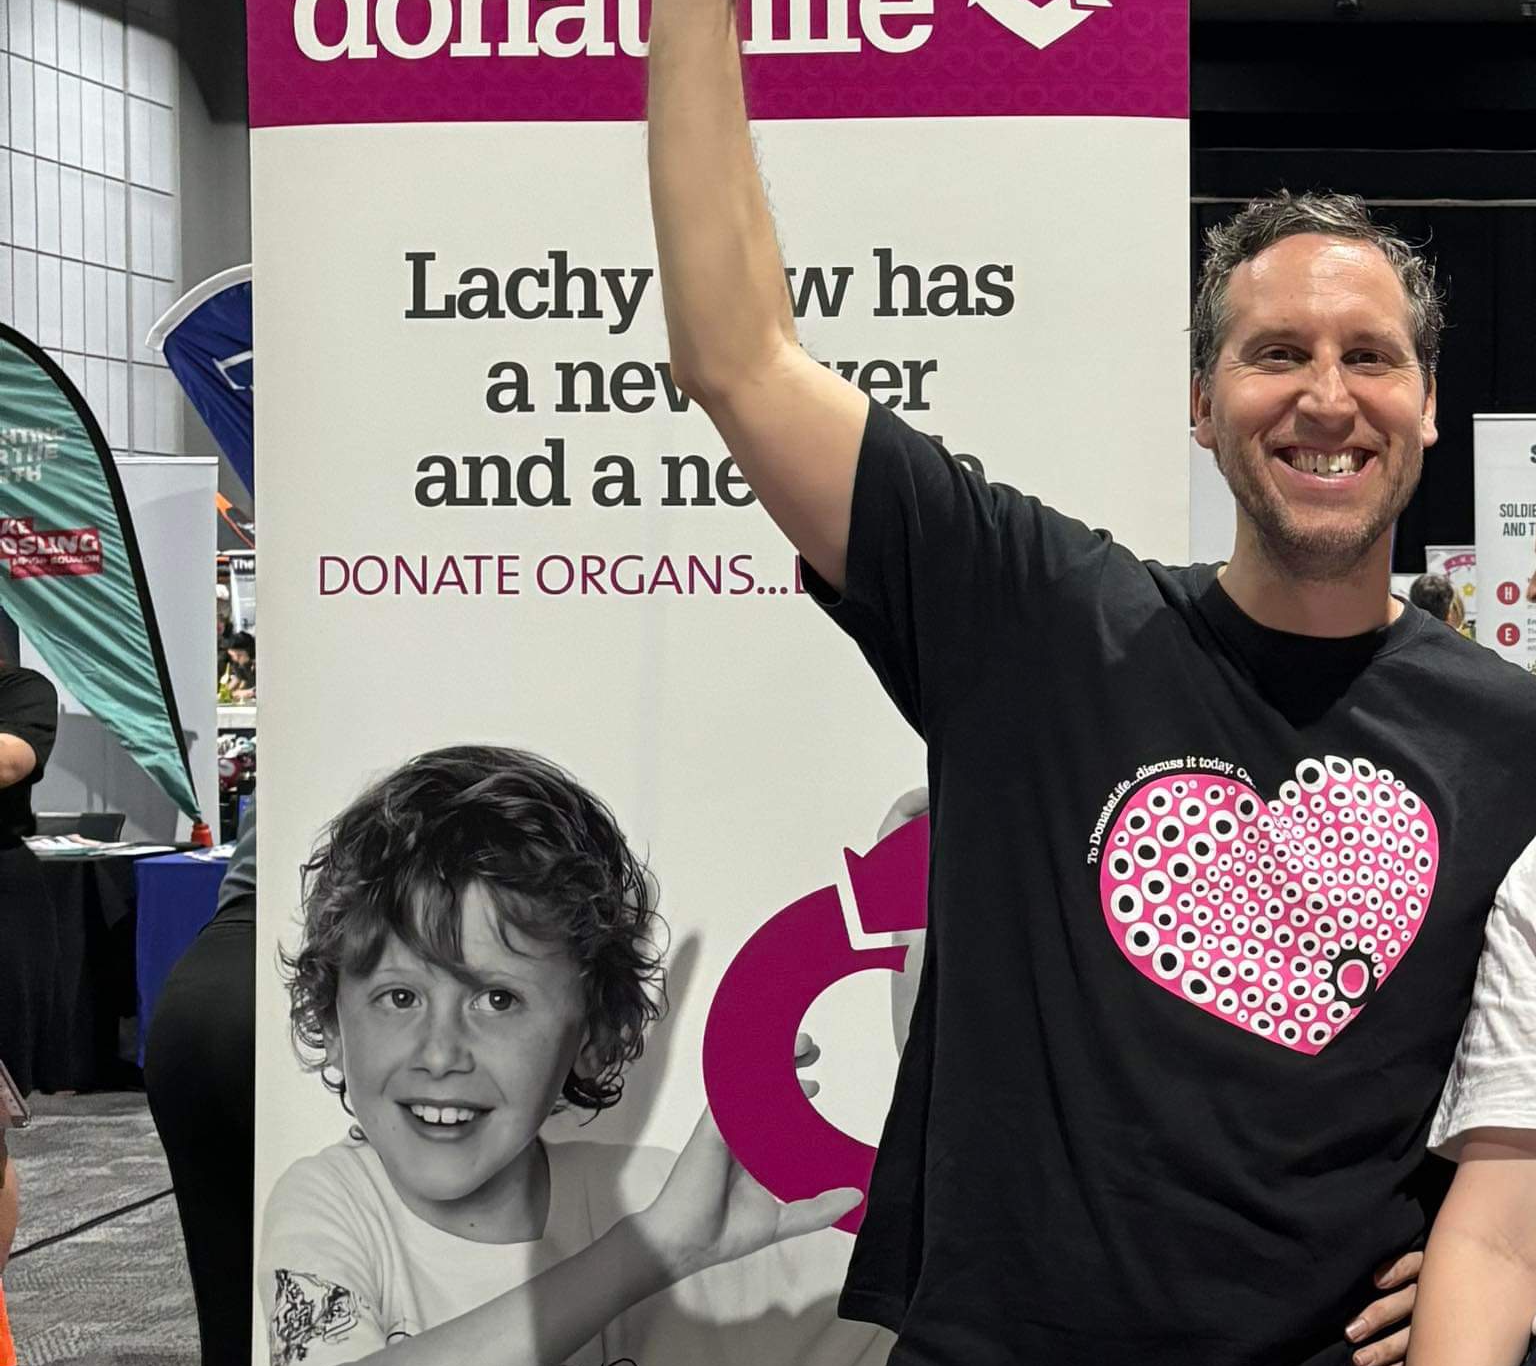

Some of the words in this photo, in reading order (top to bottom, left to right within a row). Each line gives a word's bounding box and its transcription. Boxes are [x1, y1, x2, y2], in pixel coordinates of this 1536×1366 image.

[404, 250, 654, 335] Lachy
[872, 248, 1016, 318] has
[484, 360, 535, 413] a
[414, 437, 571, 507] and
[592, 454, 642, 507] a
[660, 453, 758, 507] ne
[1502, 522, 1527, 537] AND
[319, 555, 521, 596] DONATE
[1504, 627, 1513, 642] E
[1087, 847, 1099, 865] To
[1185, 755, 1197, 768] it
